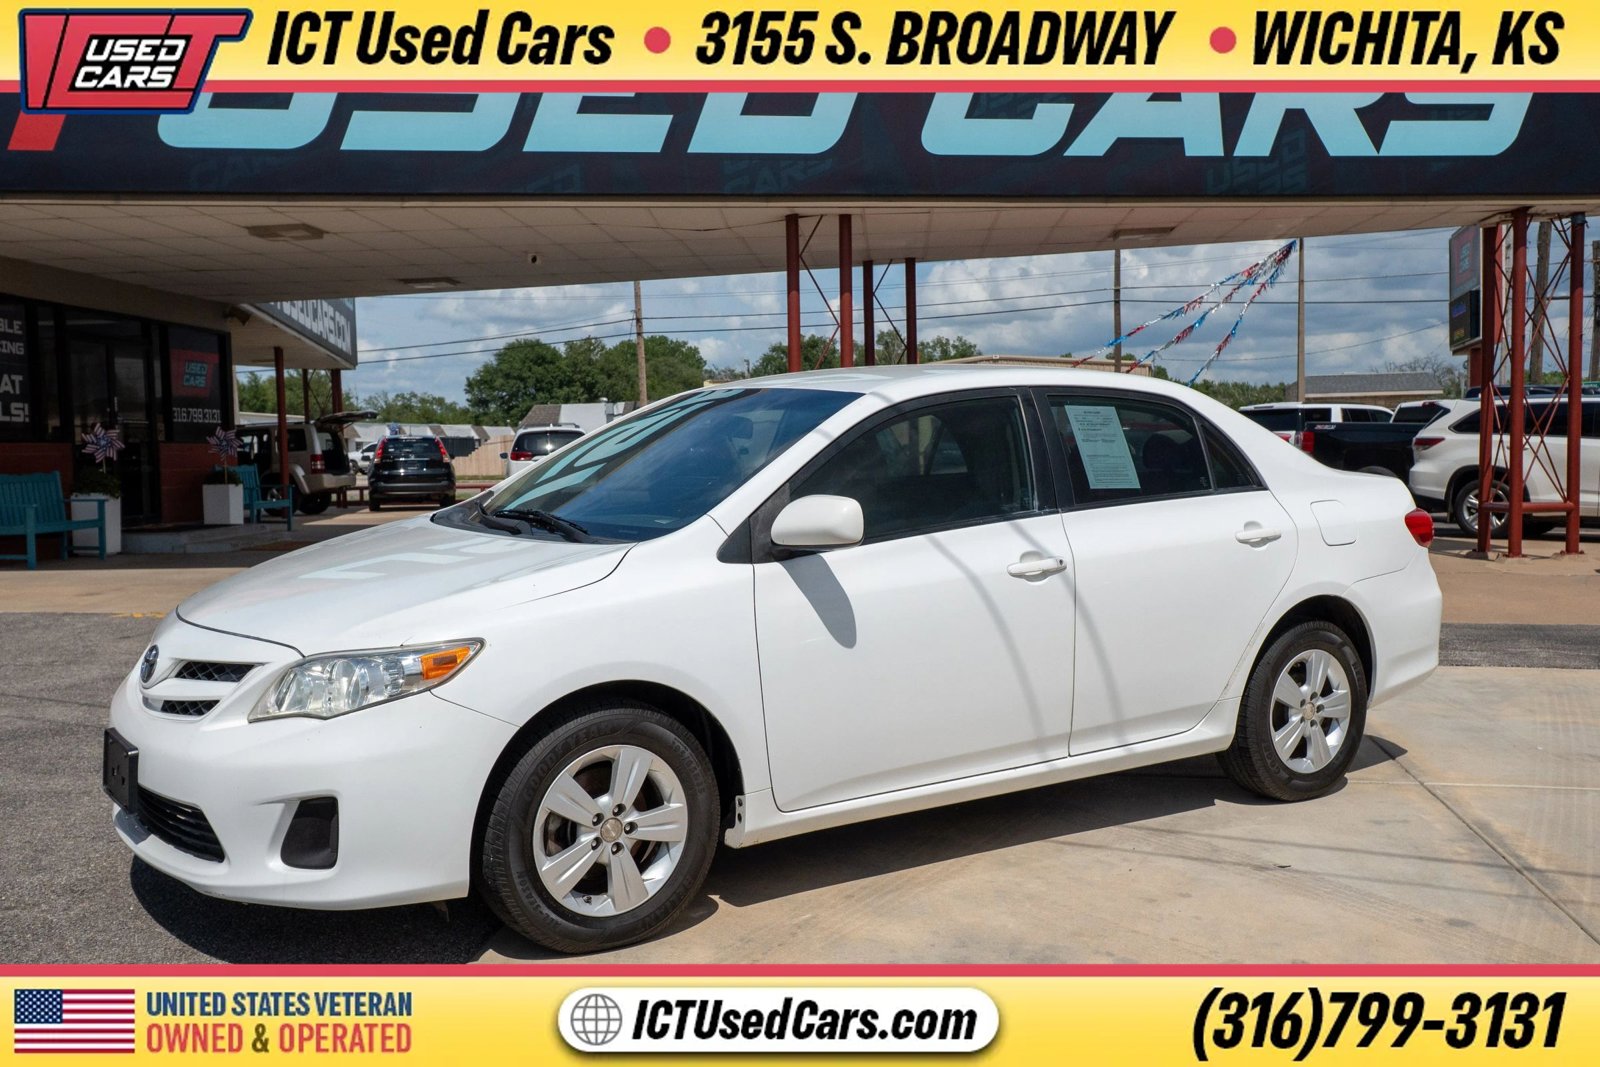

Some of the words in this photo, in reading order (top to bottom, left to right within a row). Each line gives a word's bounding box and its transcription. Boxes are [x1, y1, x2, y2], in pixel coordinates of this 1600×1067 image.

[0, 340, 24, 355] ING
[185, 361, 208, 374] USED
[183, 375, 207, 387] CARS
